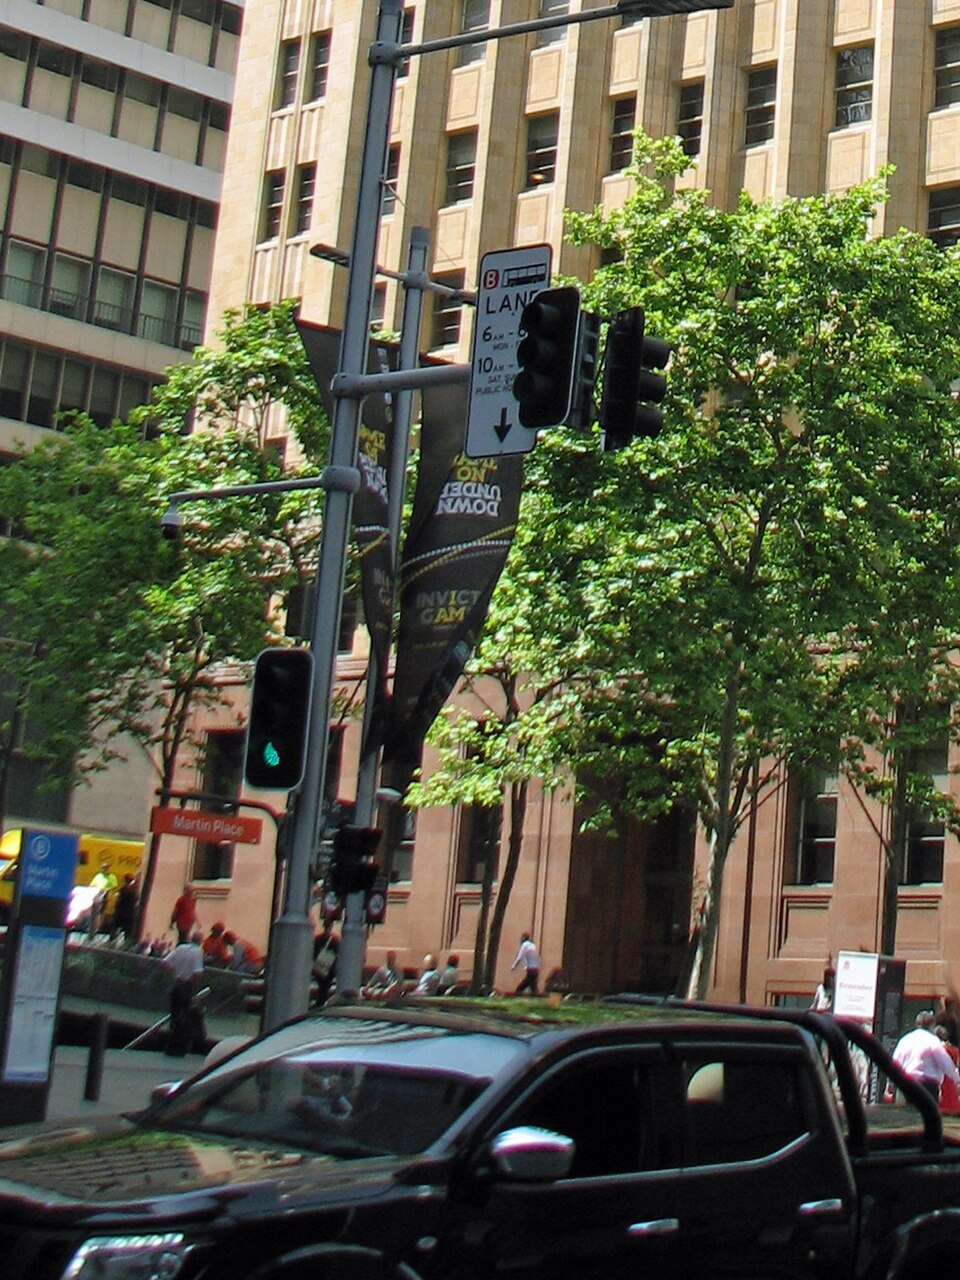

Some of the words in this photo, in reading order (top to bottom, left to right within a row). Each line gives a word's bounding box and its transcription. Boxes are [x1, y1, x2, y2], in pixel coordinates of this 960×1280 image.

[486, 271, 497, 288] B
[173, 815, 211, 832] Martin
[213, 819, 244, 837] Place
